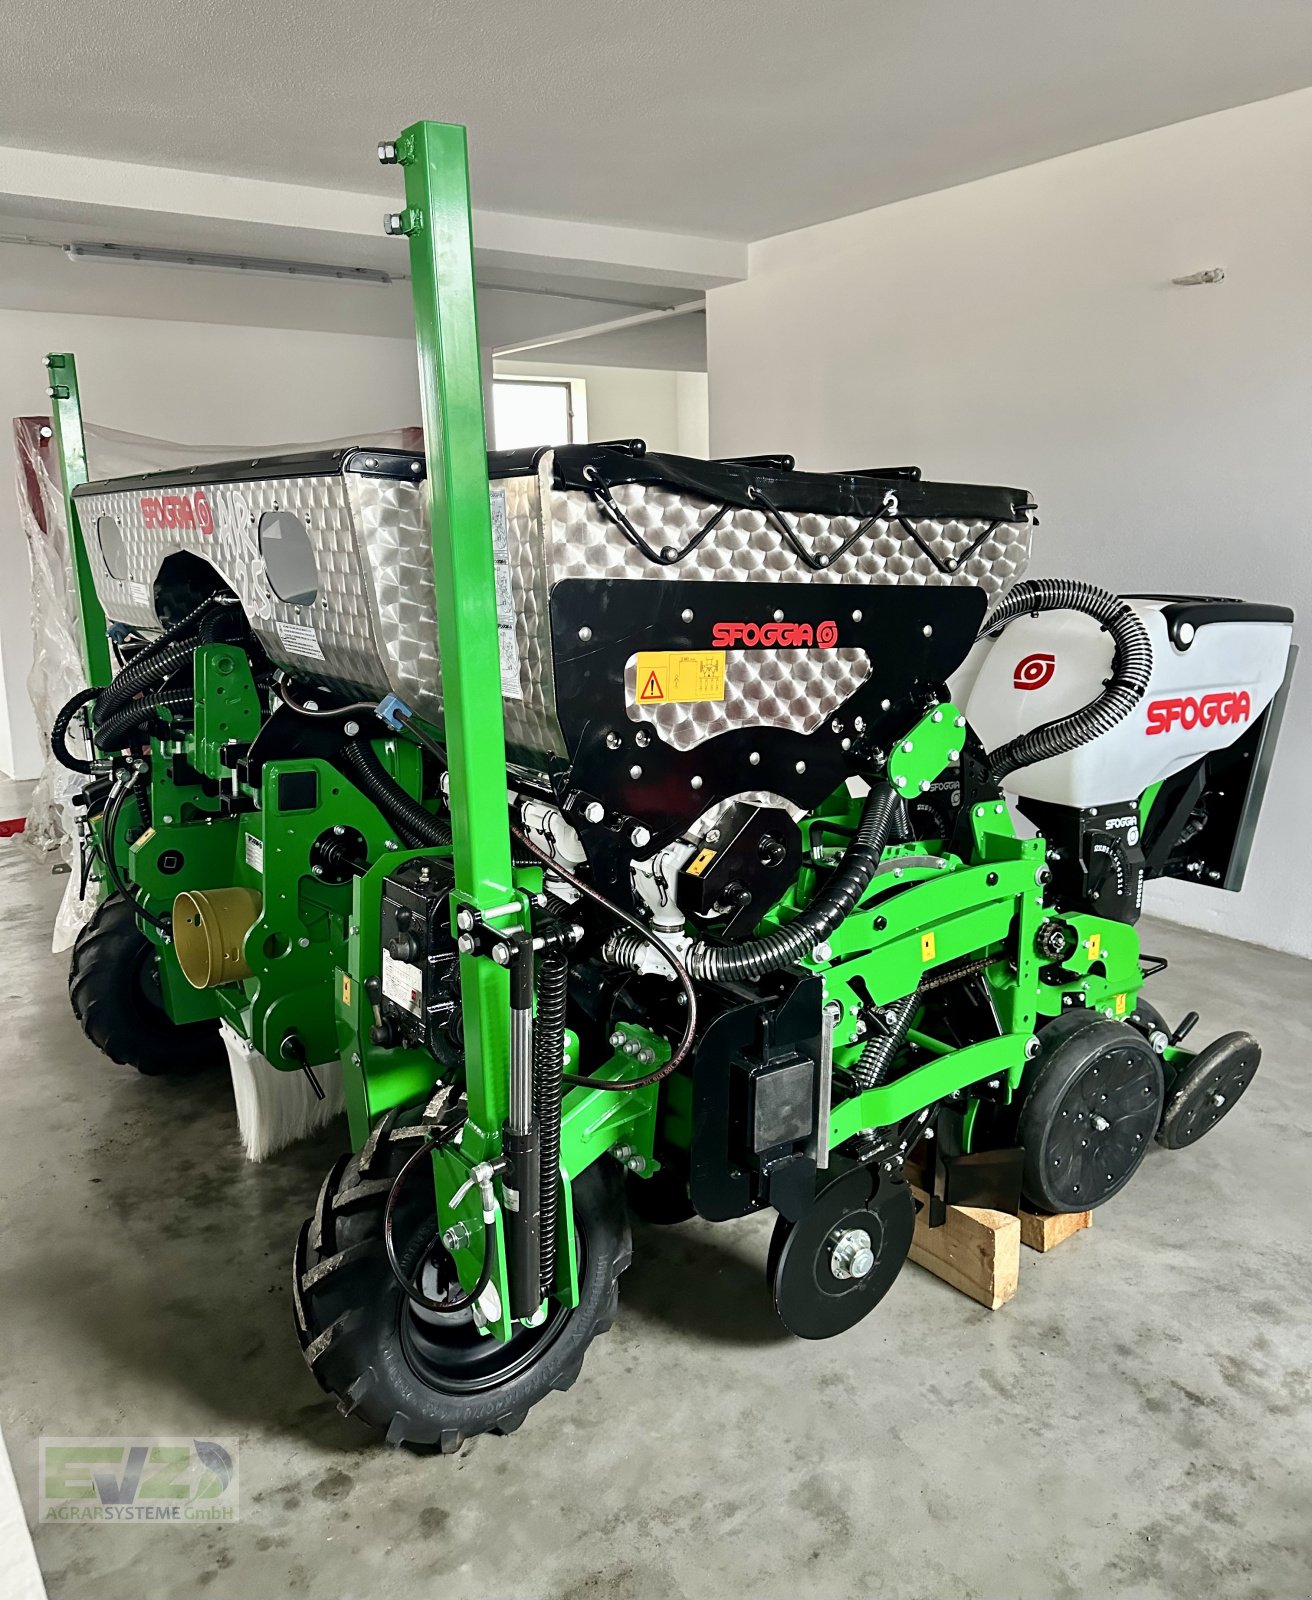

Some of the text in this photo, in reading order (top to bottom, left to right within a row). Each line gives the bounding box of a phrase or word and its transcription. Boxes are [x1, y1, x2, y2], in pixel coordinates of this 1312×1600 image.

[140, 495, 197, 531] SFOGGIA
[216, 489, 260, 562] AIR
[712, 622, 813, 647] SFOGGIA
[1145, 690, 1251, 736] SFOGGIA
[929, 780, 961, 792] SFOGGIA
[1105, 816, 1137, 830] SFOGGIA
